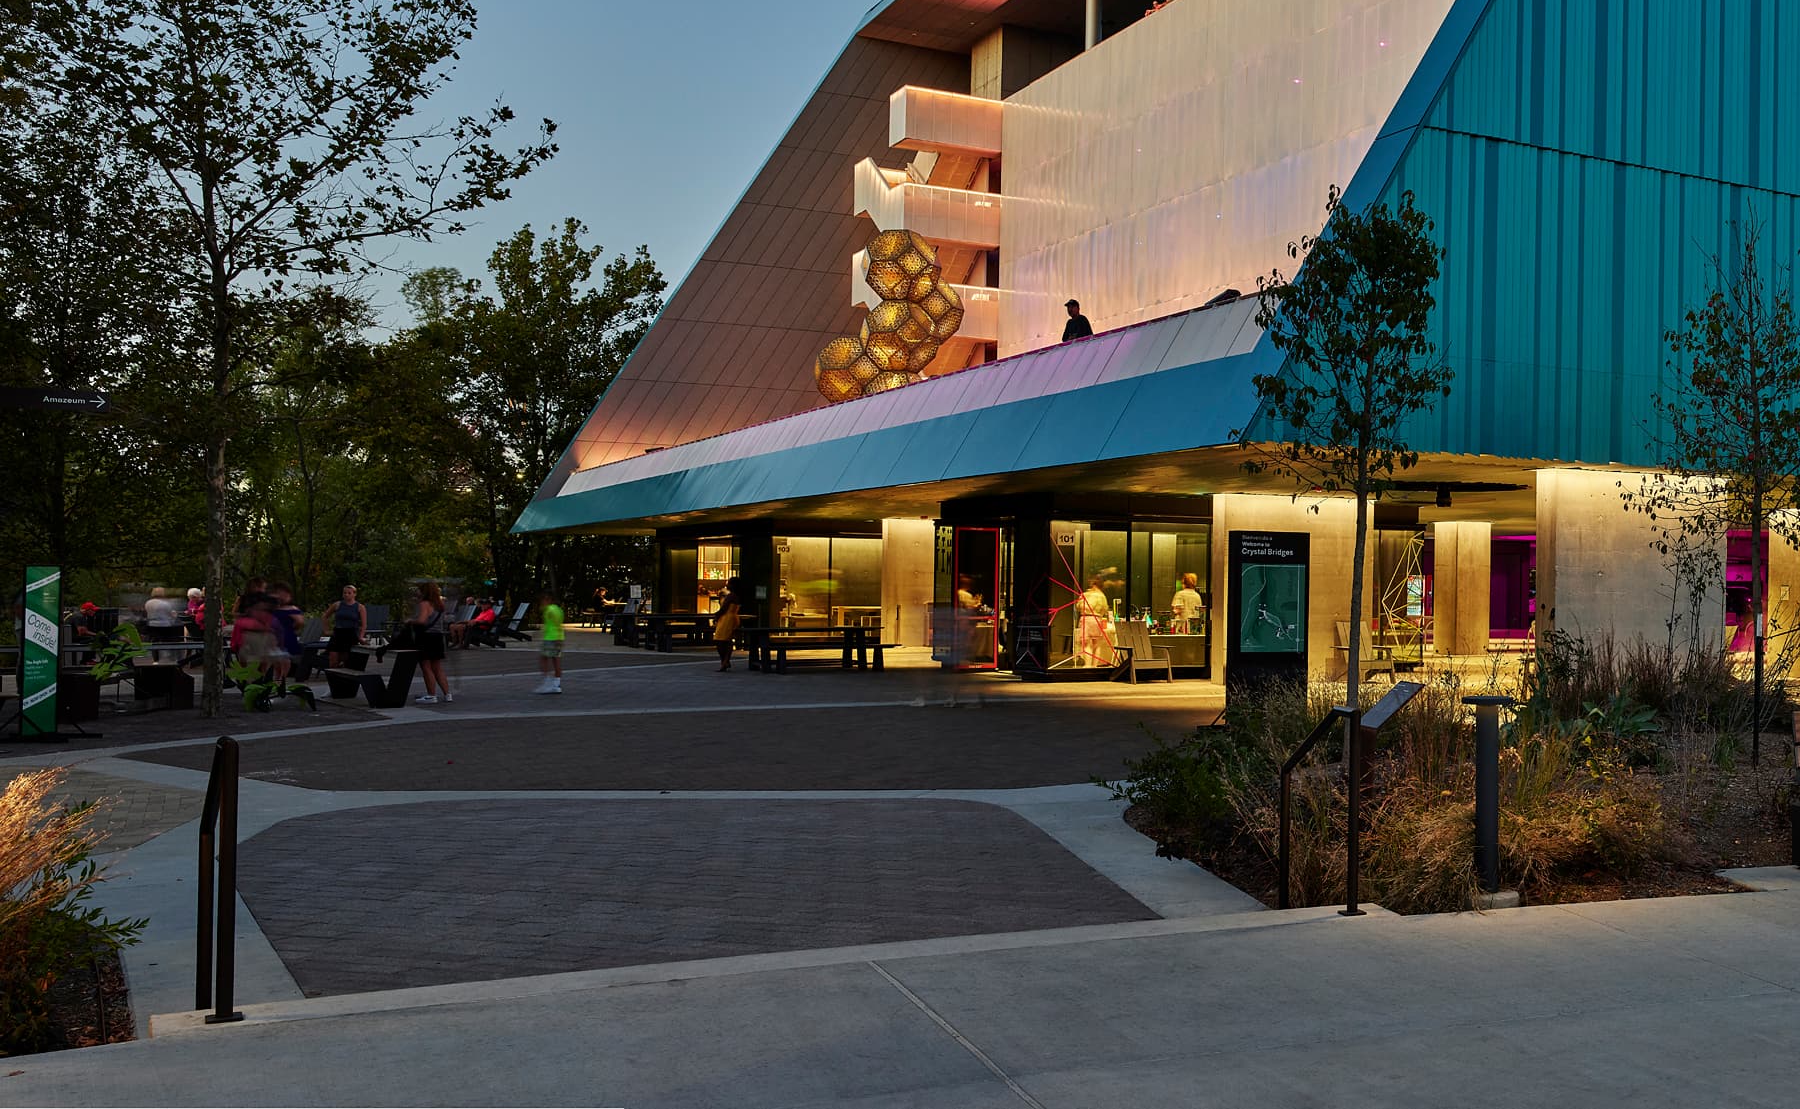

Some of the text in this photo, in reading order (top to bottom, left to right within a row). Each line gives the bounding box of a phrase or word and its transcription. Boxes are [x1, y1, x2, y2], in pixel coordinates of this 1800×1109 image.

[42, 396, 86, 404] Amazeum
[1059, 535, 1074, 543] 101
[1241, 547, 1294, 558] Crystal Bridges
[27, 613, 51, 634] Come
